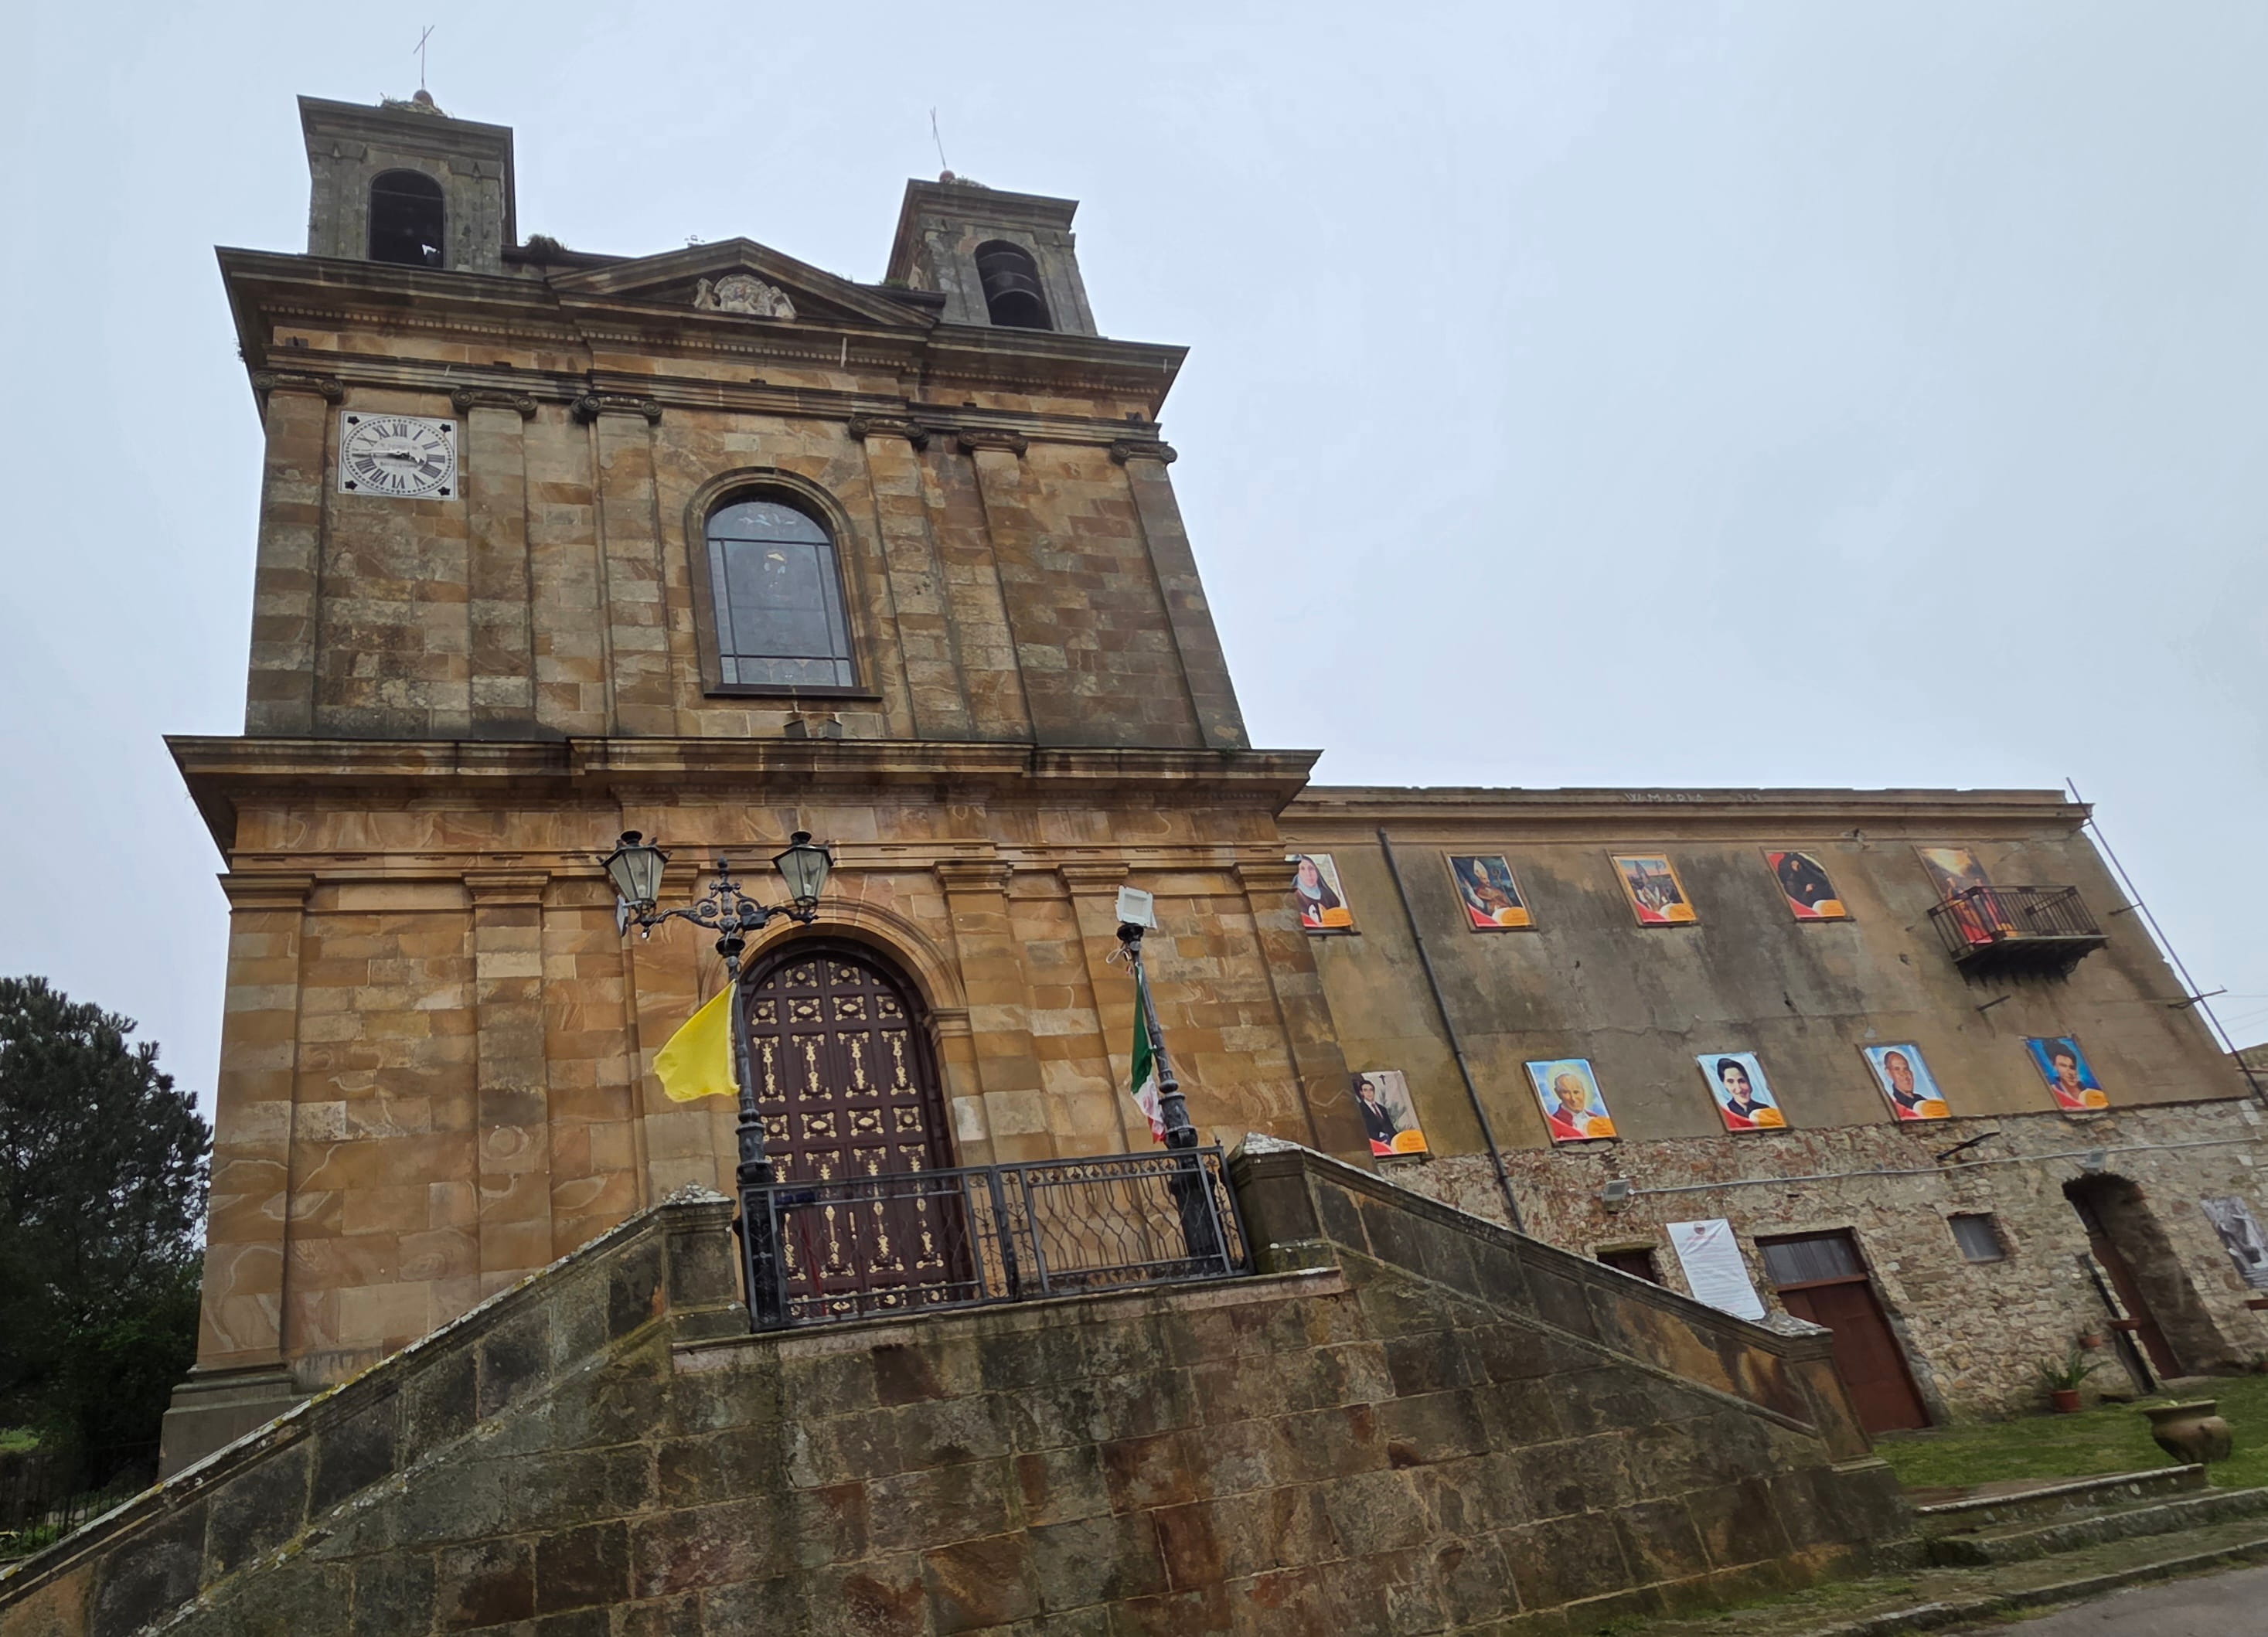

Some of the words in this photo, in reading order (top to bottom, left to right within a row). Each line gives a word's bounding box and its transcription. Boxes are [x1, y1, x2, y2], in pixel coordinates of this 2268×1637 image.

[372, 424, 390, 440] XI
[392, 423, 407, 437] XII
[412, 429, 424, 441] I
[356, 433, 378, 447] X
[421, 441, 441, 450] II
[426, 454, 446, 464] III
[369, 468, 390, 485] VII
[392, 474, 405, 488] VI
[412, 473, 426, 487] V
